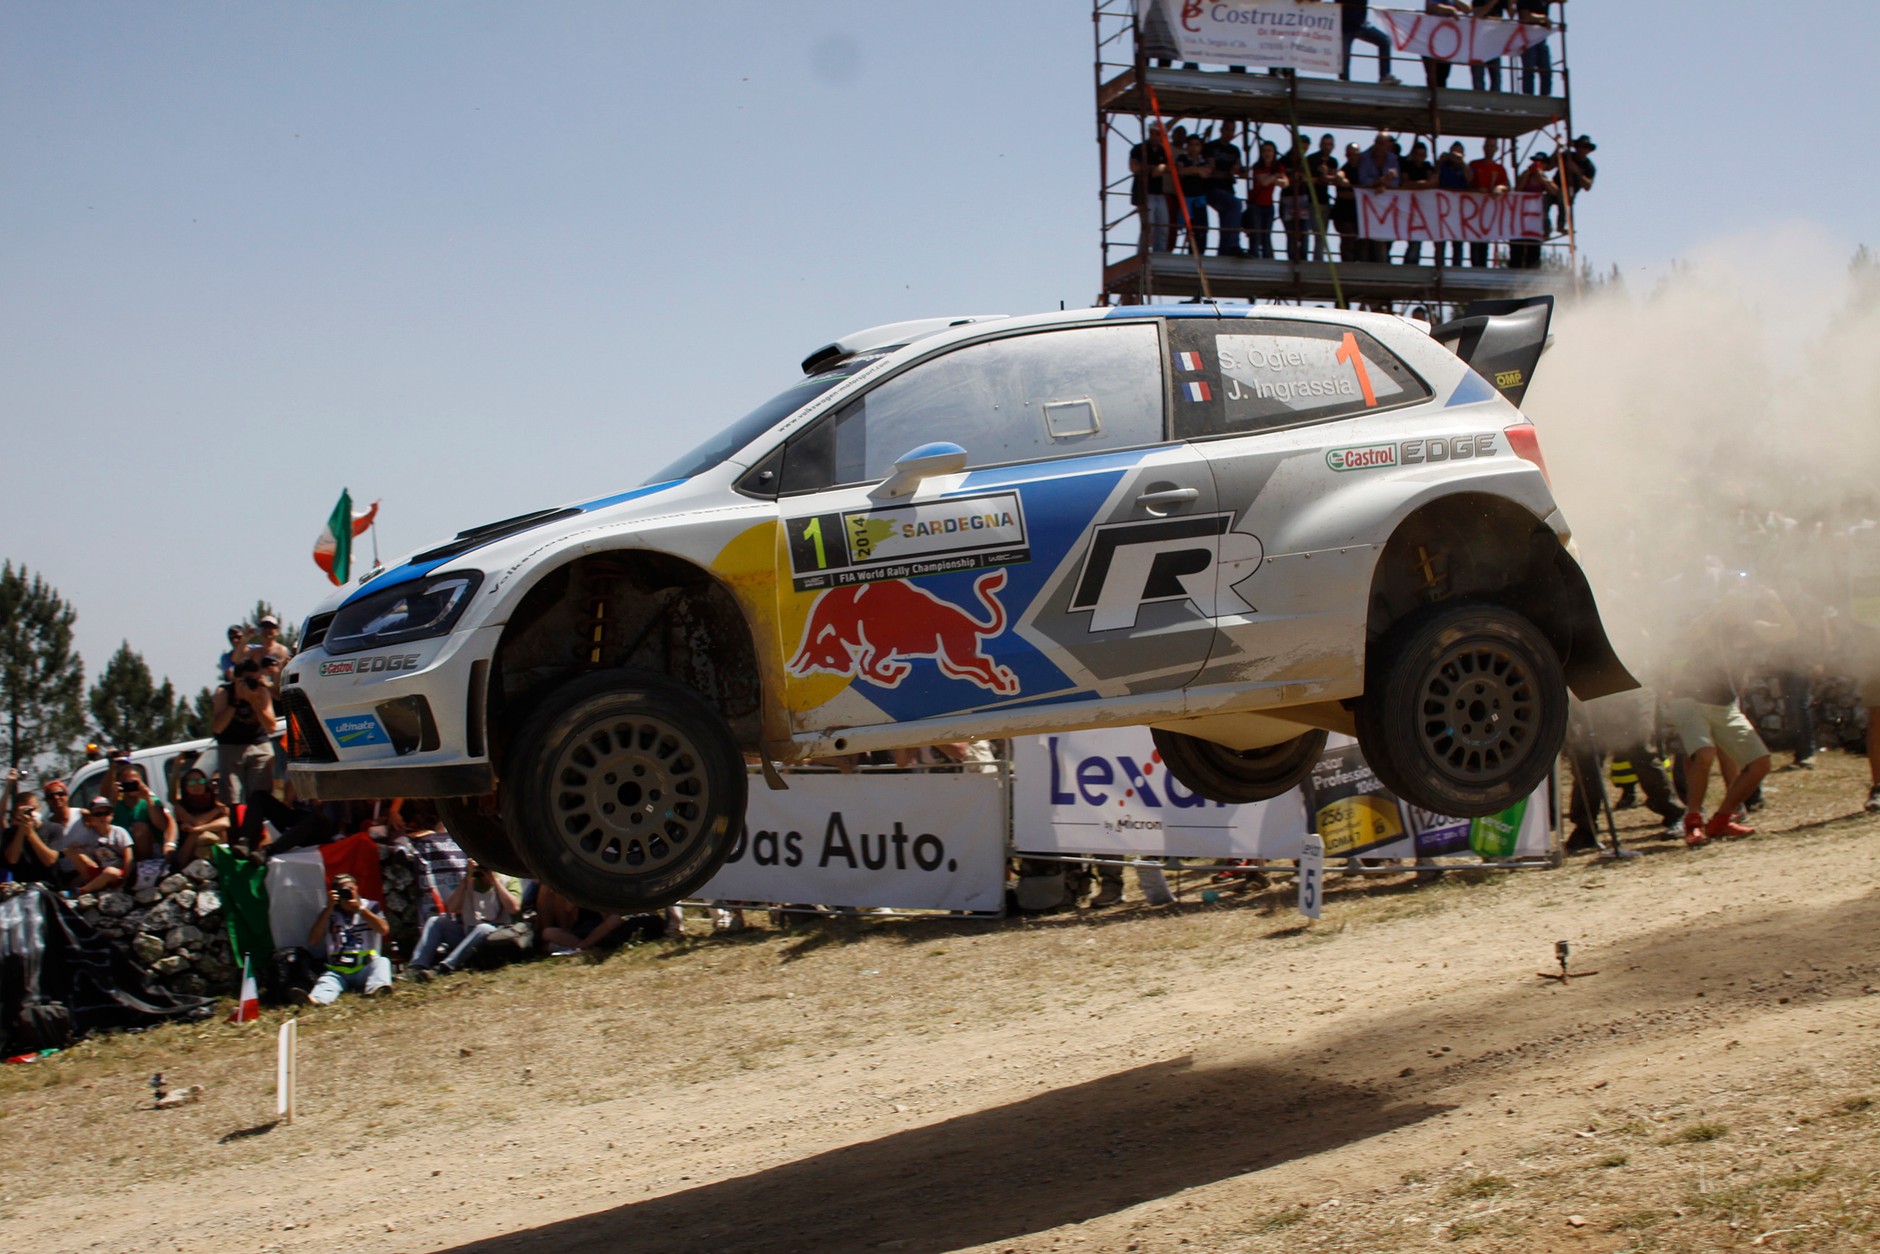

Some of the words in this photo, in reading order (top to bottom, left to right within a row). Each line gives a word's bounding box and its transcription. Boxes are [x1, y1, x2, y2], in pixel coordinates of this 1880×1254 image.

[1210, 3, 1336, 31] Costruzioni
[1383, 10, 1531, 65] VOLA
[1362, 192, 1544, 240] MARRONE
[1219, 350, 1242, 369] S.
[1248, 350, 1306, 371] Ogier
[1336, 332, 1377, 407] 1
[1496, 372, 1523, 386] OMP
[778, 360, 890, 432] www.volkswagen-motorsport.com
[1227, 378, 1249, 400] J.
[1254, 376, 1354, 401] Ingrassia
[1344, 447, 1395, 468] Castrol
[1400, 433, 1497, 465] EDGE
[803, 517, 827, 569] 1
[852, 517, 871, 558] 2014
[902, 511, 1014, 539] SARDEGNA
[487, 529, 591, 595] Volkswagen
[839, 573, 855, 584] FIA
[857, 569, 885, 581] World
[886, 566, 911, 579] Rally
[911, 557, 976, 575] Championship
[1066, 510, 1264, 633] R
[327, 659, 353, 674] Castrol
[356, 653, 421, 673] EDGE
[335, 720, 375, 732] ultimate
[1049, 737, 1225, 809] Lexa
[1312, 765, 1374, 790] Professio
[818, 811, 958, 872] Auto.
[1115, 814, 1163, 832] Micron
[1304, 869, 1316, 910] 5
